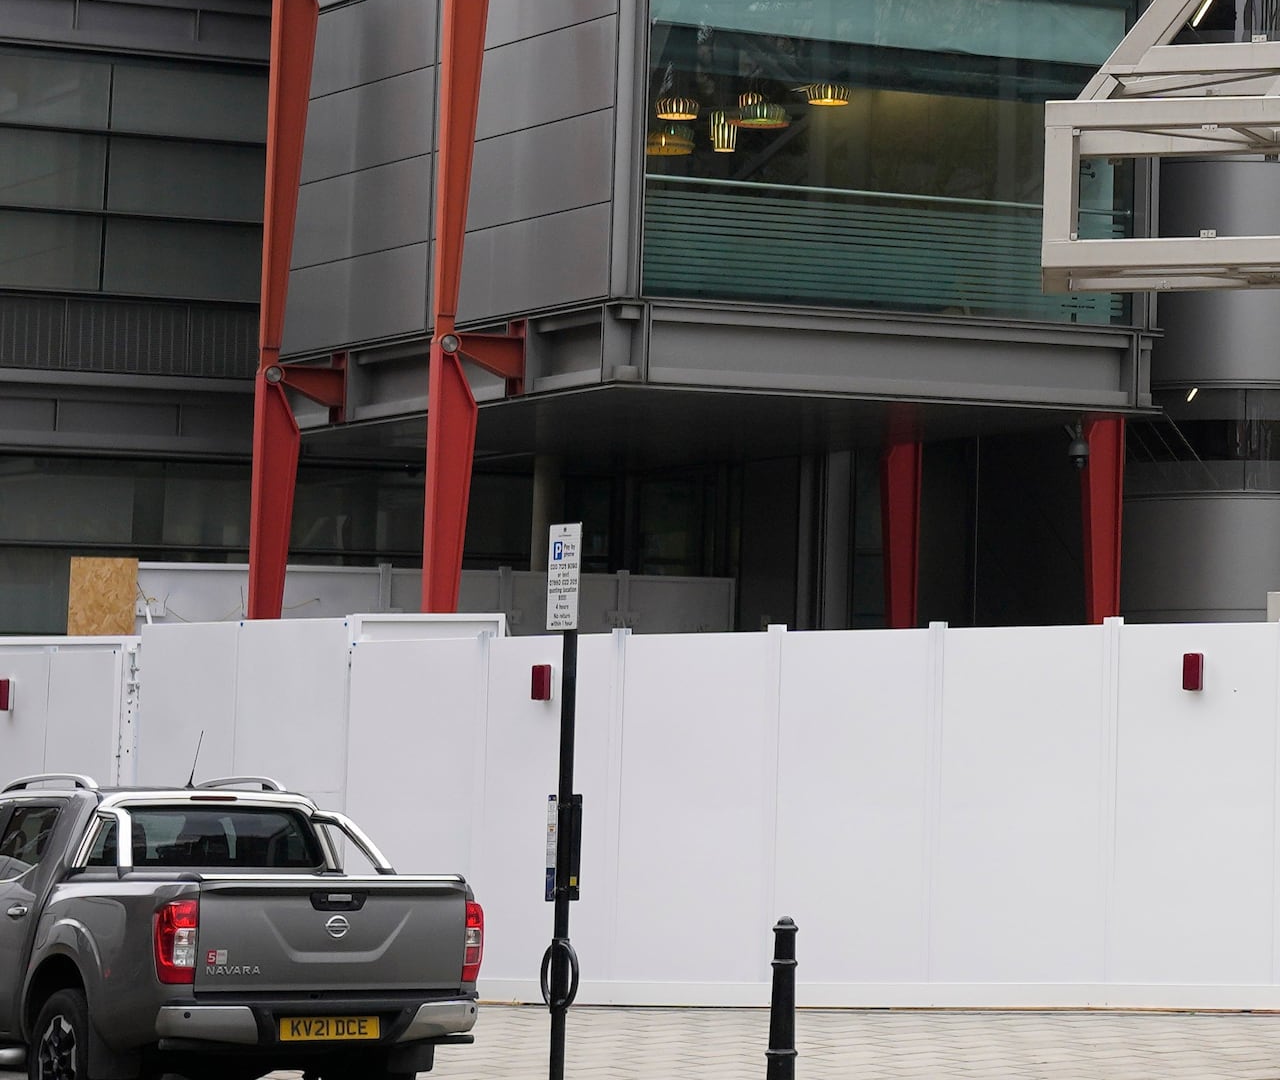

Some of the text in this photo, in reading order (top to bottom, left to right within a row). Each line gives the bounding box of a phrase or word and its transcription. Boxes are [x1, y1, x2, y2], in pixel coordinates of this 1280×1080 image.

[206, 966, 261, 975] NAVARA
[291, 1019, 368, 1037] KV21 DCE
